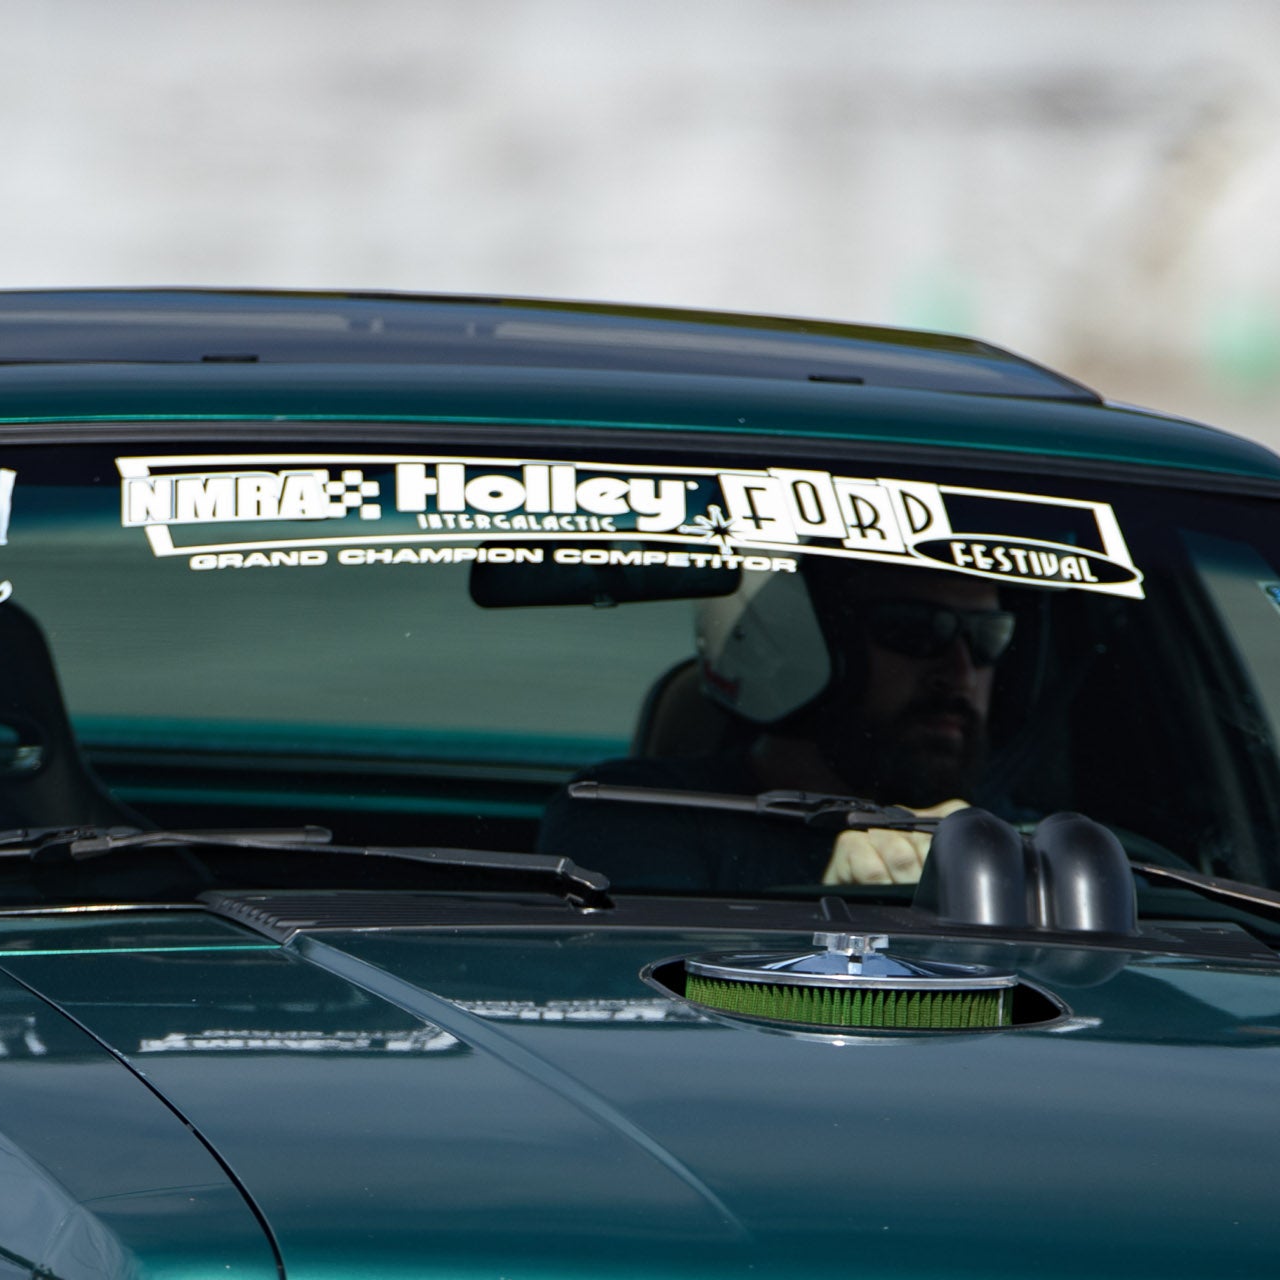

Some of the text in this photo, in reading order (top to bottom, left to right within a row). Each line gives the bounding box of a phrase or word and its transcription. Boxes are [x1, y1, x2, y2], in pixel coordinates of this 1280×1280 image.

[123, 469, 330, 526] NMRA
[396, 463, 686, 532] Holley
[417, 513, 617, 532] INTERGALACTIC
[740, 478, 1099, 583] FORD FESTIVAL
[189, 548, 798, 573] GRAND CHAMPION COMPETITOR
